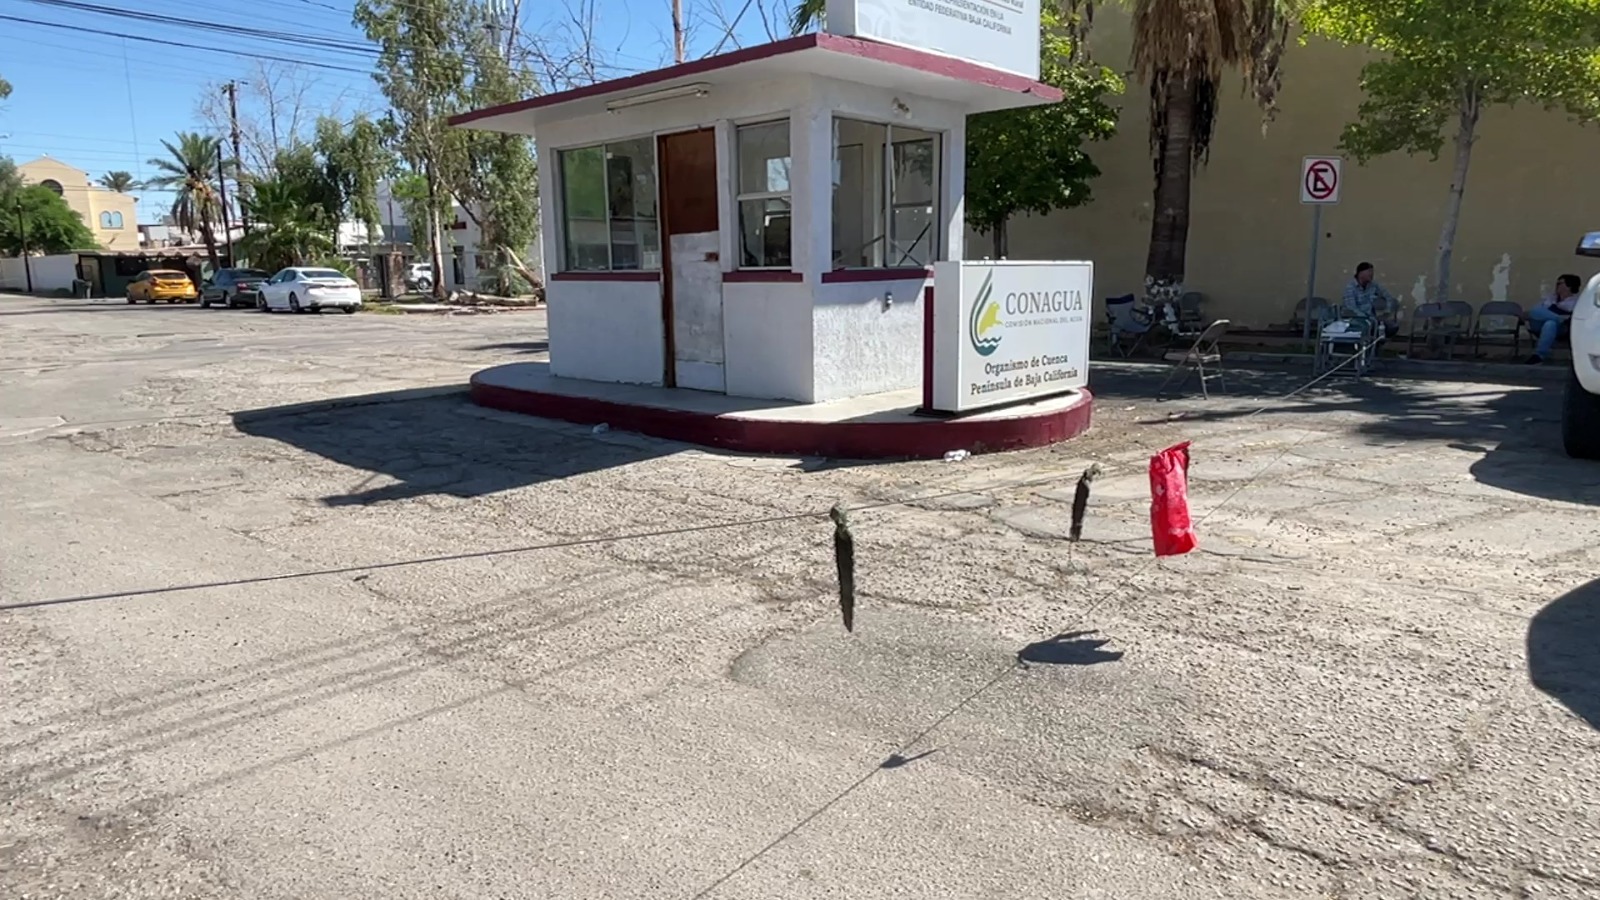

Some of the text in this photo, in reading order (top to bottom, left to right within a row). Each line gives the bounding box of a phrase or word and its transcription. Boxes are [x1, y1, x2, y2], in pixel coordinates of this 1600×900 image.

[935, 3, 967, 20] FEDERATIVA
[969, 13, 982, 25] BAJA
[983, 18, 1012, 34] CALIFORNIA
[1005, 290, 1083, 315] CONAGUA
[1033, 317, 1059, 325] NACIONAL
[984, 354, 1068, 376] Organismo de Cuenca
[1013, 375, 1023, 387] de
[1025, 373, 1042, 387] Baja
[1043, 367, 1078, 382] California
